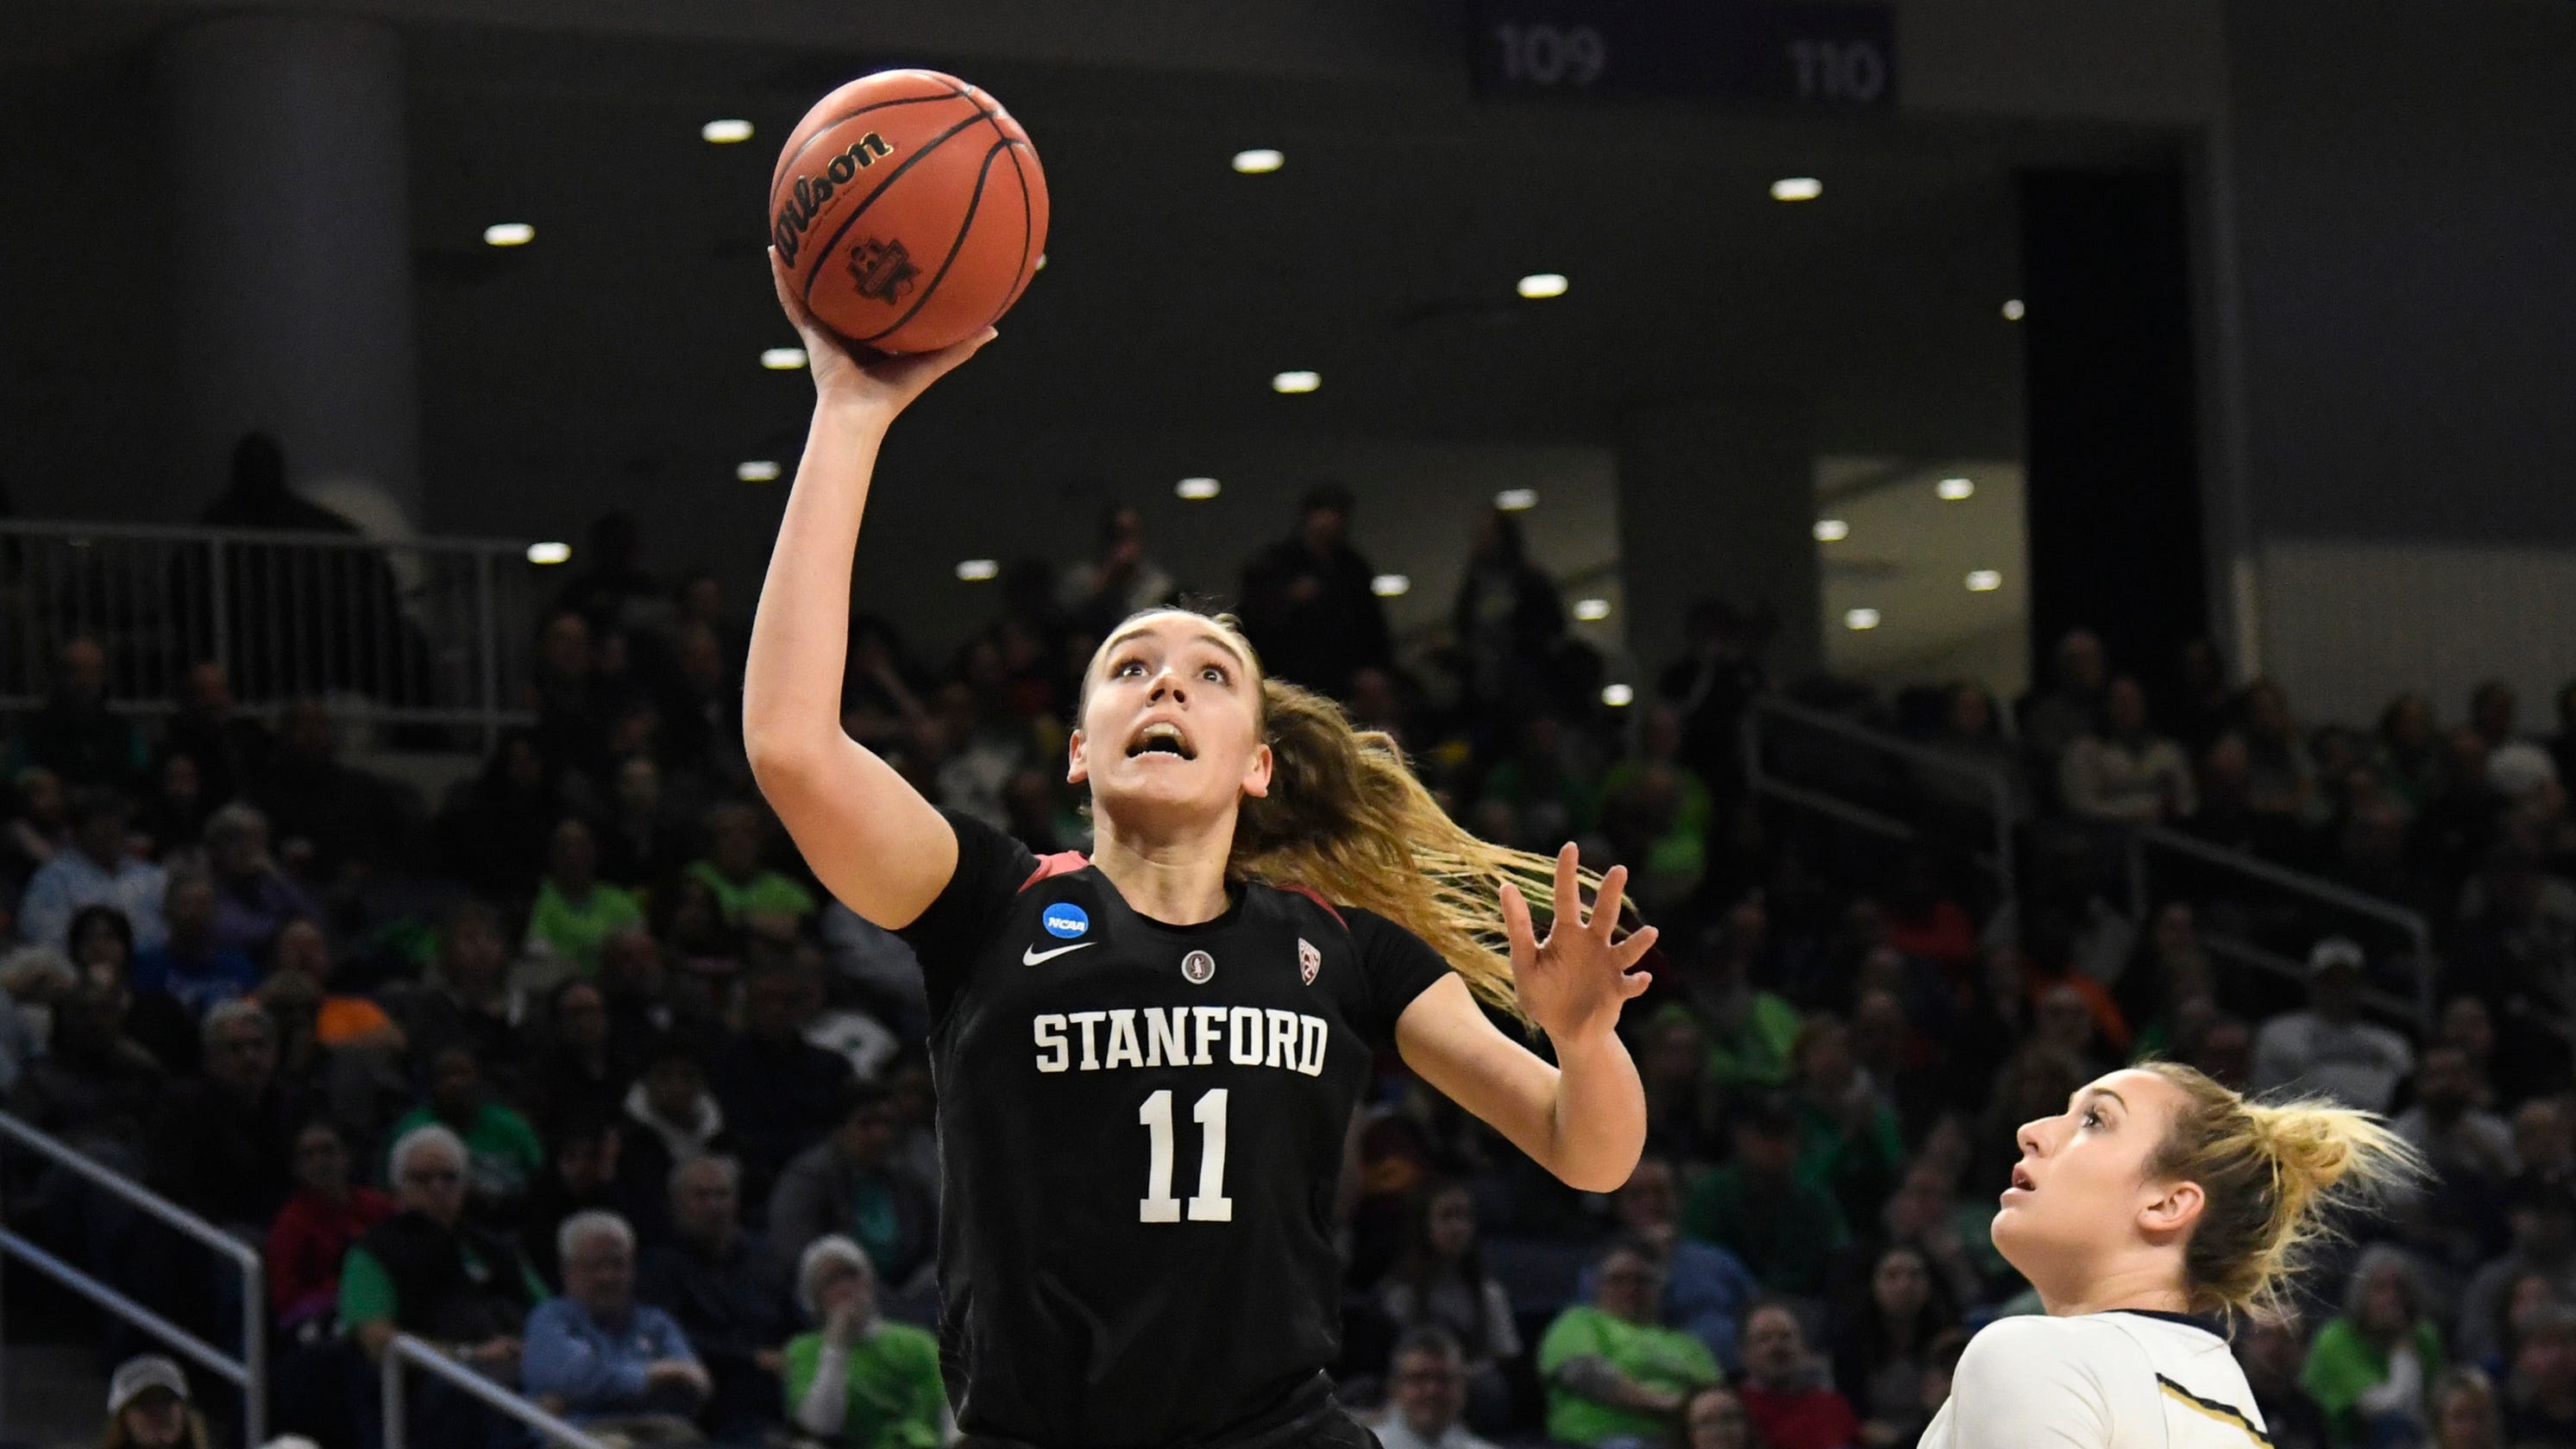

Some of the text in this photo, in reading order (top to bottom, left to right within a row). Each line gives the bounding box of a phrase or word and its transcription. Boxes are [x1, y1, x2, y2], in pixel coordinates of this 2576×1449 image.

[1496, 24, 1606, 85] 109
[1790, 40, 1887, 101] 110
[775, 132, 895, 268] Wilson
[1048, 917, 1085, 932] NCAA
[1034, 1006, 1329, 1077] STANFORD
[1140, 1088, 1232, 1223] 11
